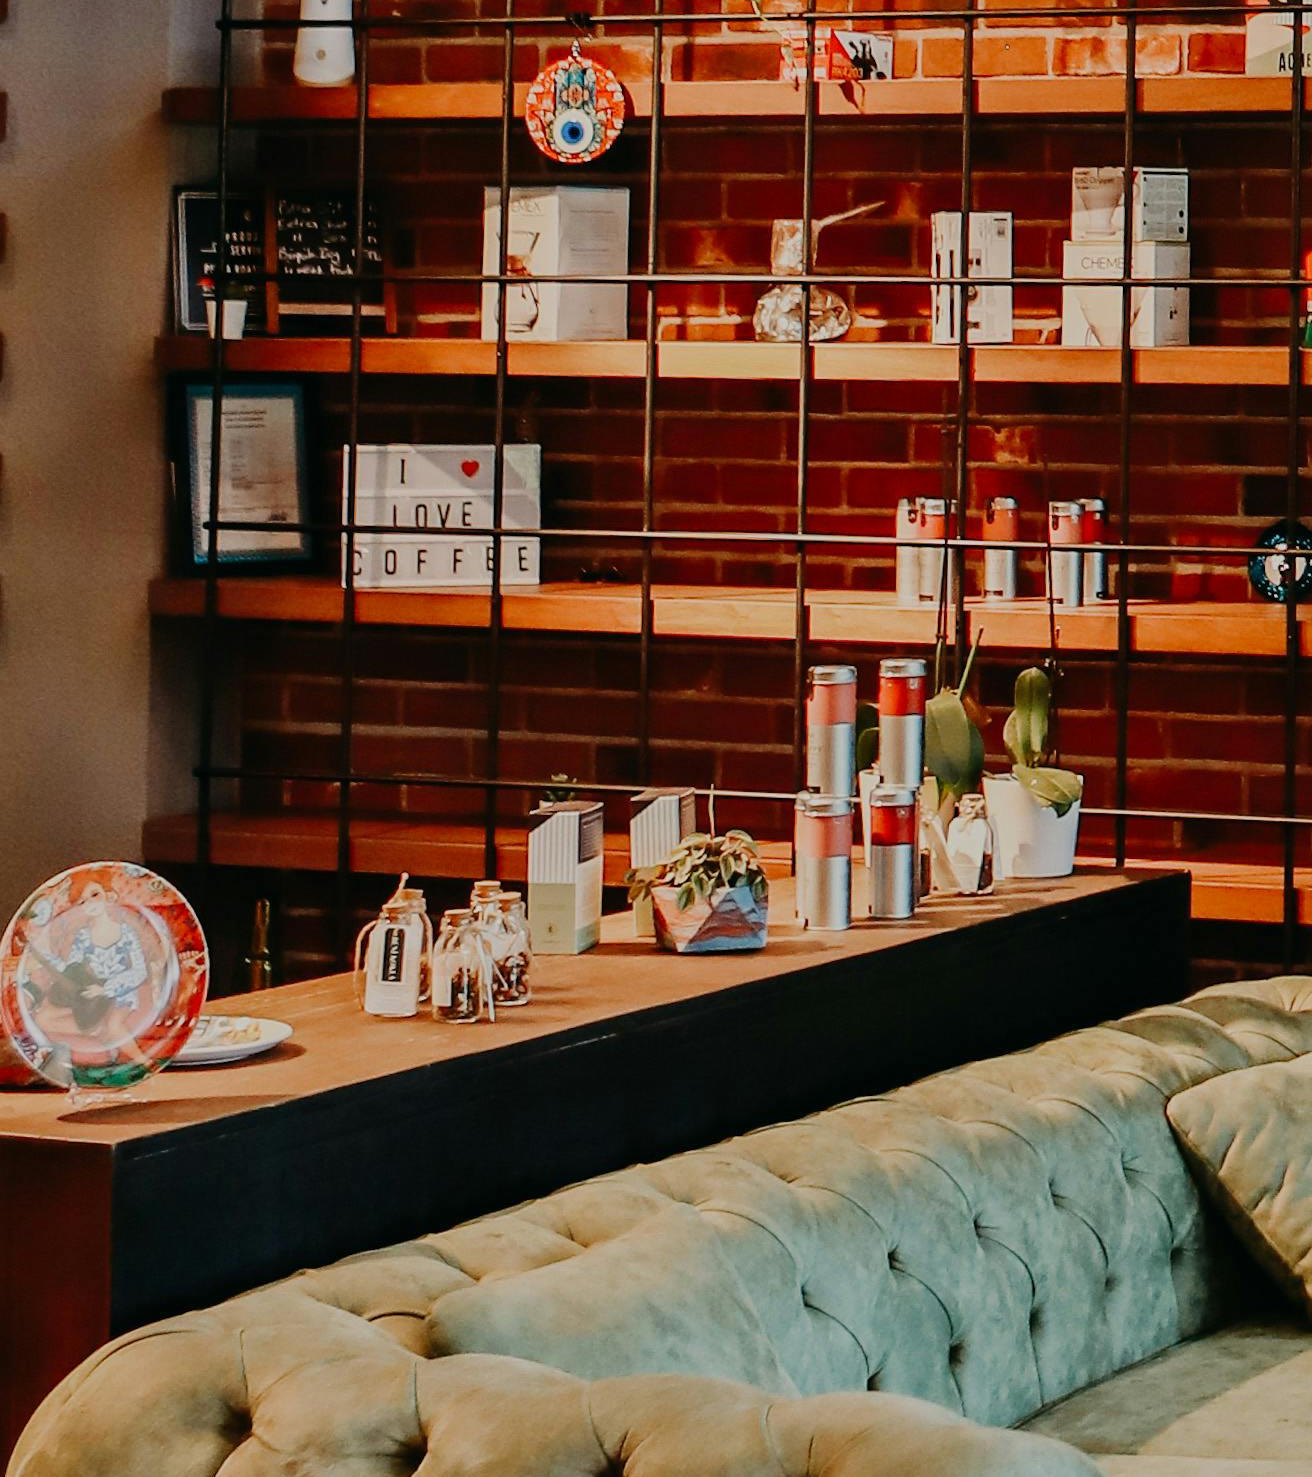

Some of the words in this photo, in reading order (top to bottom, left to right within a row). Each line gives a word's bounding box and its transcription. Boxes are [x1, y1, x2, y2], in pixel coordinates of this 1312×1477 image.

[400, 458, 406, 485] I
[393, 501, 473, 529] LOVE
[353, 546, 530, 576] COFFEE
